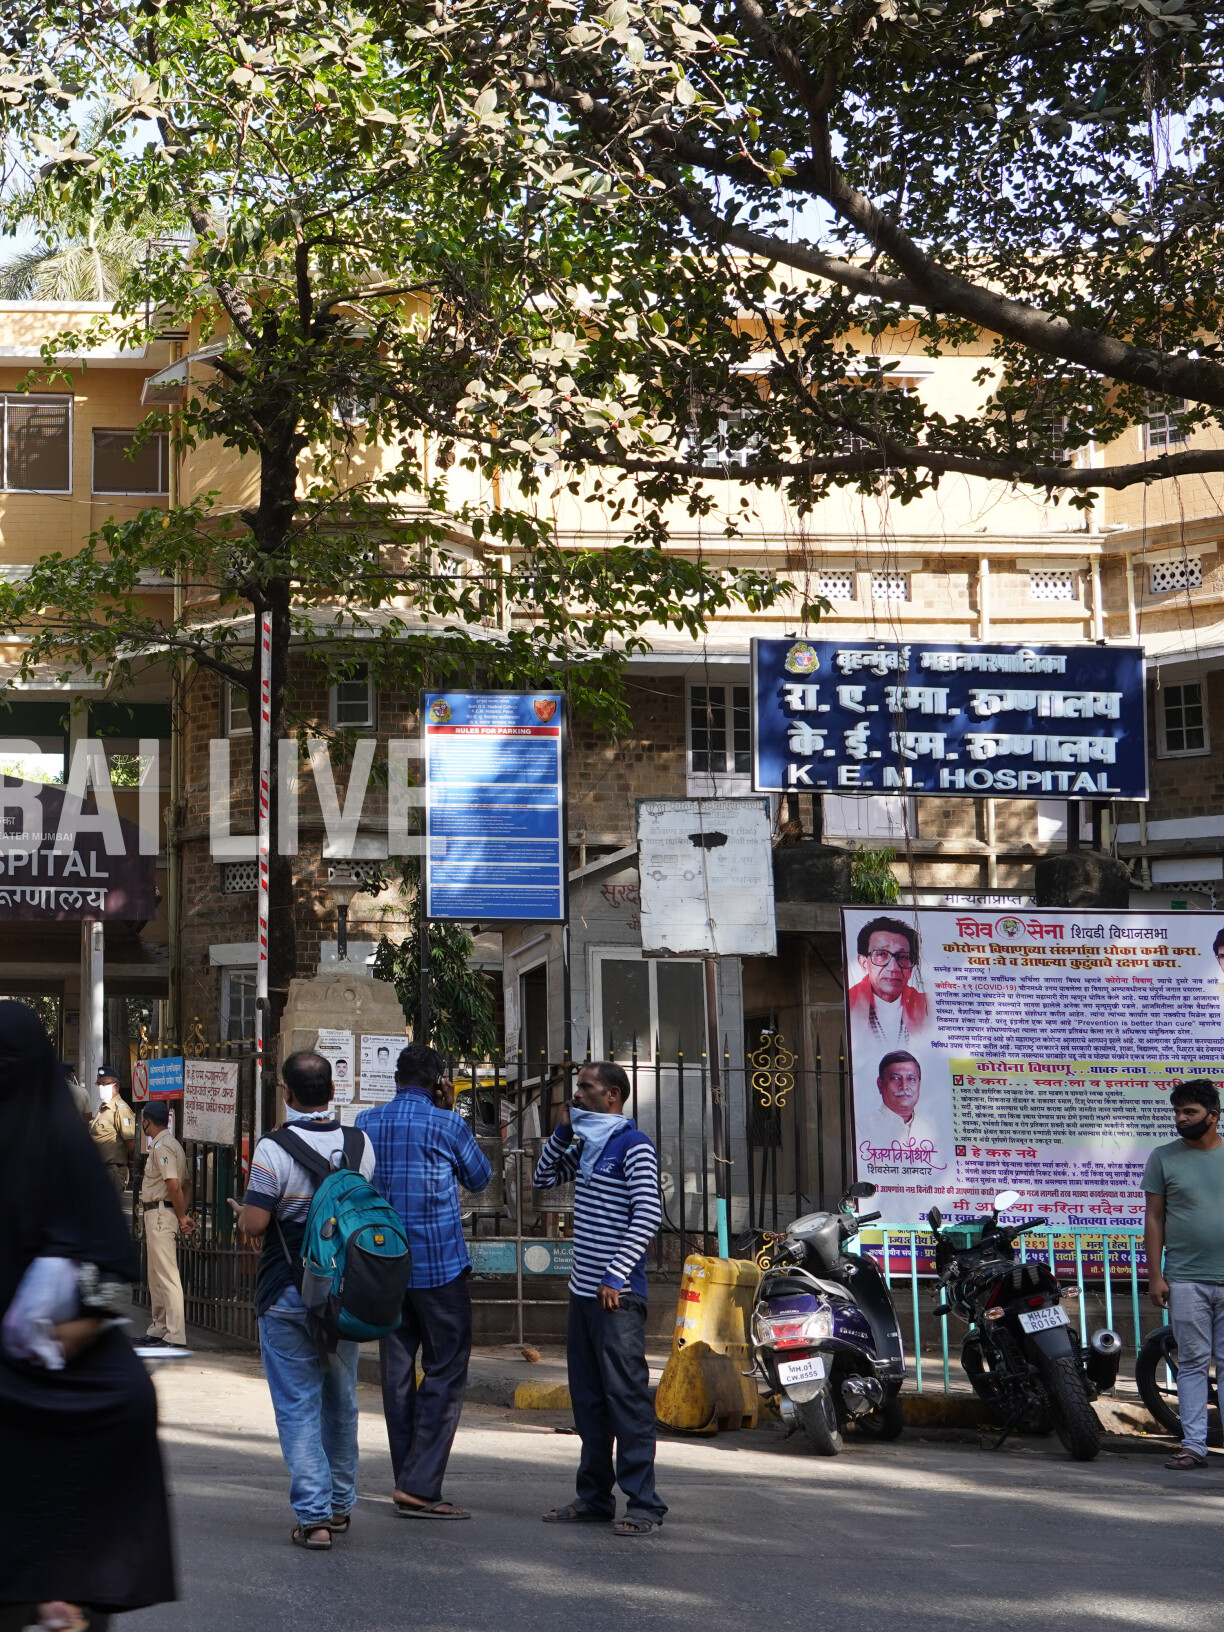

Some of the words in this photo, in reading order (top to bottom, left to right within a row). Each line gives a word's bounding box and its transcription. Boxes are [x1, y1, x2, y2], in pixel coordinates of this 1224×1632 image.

[920, 649, 1068, 675] महानगरपालिका
[836, 685, 879, 714] ए.
[455, 727, 479, 735] RULES
[481, 727, 496, 735] FOR
[787, 720, 836, 757] के.
[889, 731, 959, 761] एम.
[787, 764, 827, 787] K.
[838, 765, 873, 787] E.
[883, 766, 924, 790] M.
[939, 768, 1121, 793] HOSPITAL
[32, 832, 74, 842] MUMBAI
[956, 917, 993, 940] शिव
[1027, 918, 1065, 941] सेना
[1070, 924, 1105, 940] शिवडी
[1109, 924, 1169, 940] विधानसभा
[942, 941, 987, 954] कोरोना
[1049, 942, 1101, 956] संसर्गाचा
[1103, 944, 1137, 956] धोका
[1139, 945, 1169, 956] कमी
[1171, 947, 1202, 957] करा.
[1009, 957, 1018, 966] व
[1021, 957, 1067, 967] आपल्या
[1116, 958, 1150, 968] रक्षण
[1152, 958, 1182, 968] करा.
[976, 983, 1017, 992] (COVID-19)
[1104, 976, 1129, 984] कोरोना
[1132, 976, 1155, 986] विषाणू
[976, 1060, 1025, 1073] कोरोना
[1165, 1066, 1184, 1075] पण
[966, 1074, 977, 1086] हे
[1089, 1079, 1101, 1088] व
[1105, 1078, 1150, 1088] इतरांना
[971, 1144, 982, 1157] हे
[1016, 1146, 1038, 1159] नये
[867, 1163, 899, 1175] शिवसेना
[901, 1167, 933, 1176] आमदार
[952, 1199, 971, 1211] मी
[1037, 1201, 1084, 1214] करिता
[1088, 1199, 1125, 1215] सदैव
[1068, 1215, 1108, 1226] तितक्या
[1110, 1216, 1143, 1226] लवकर
